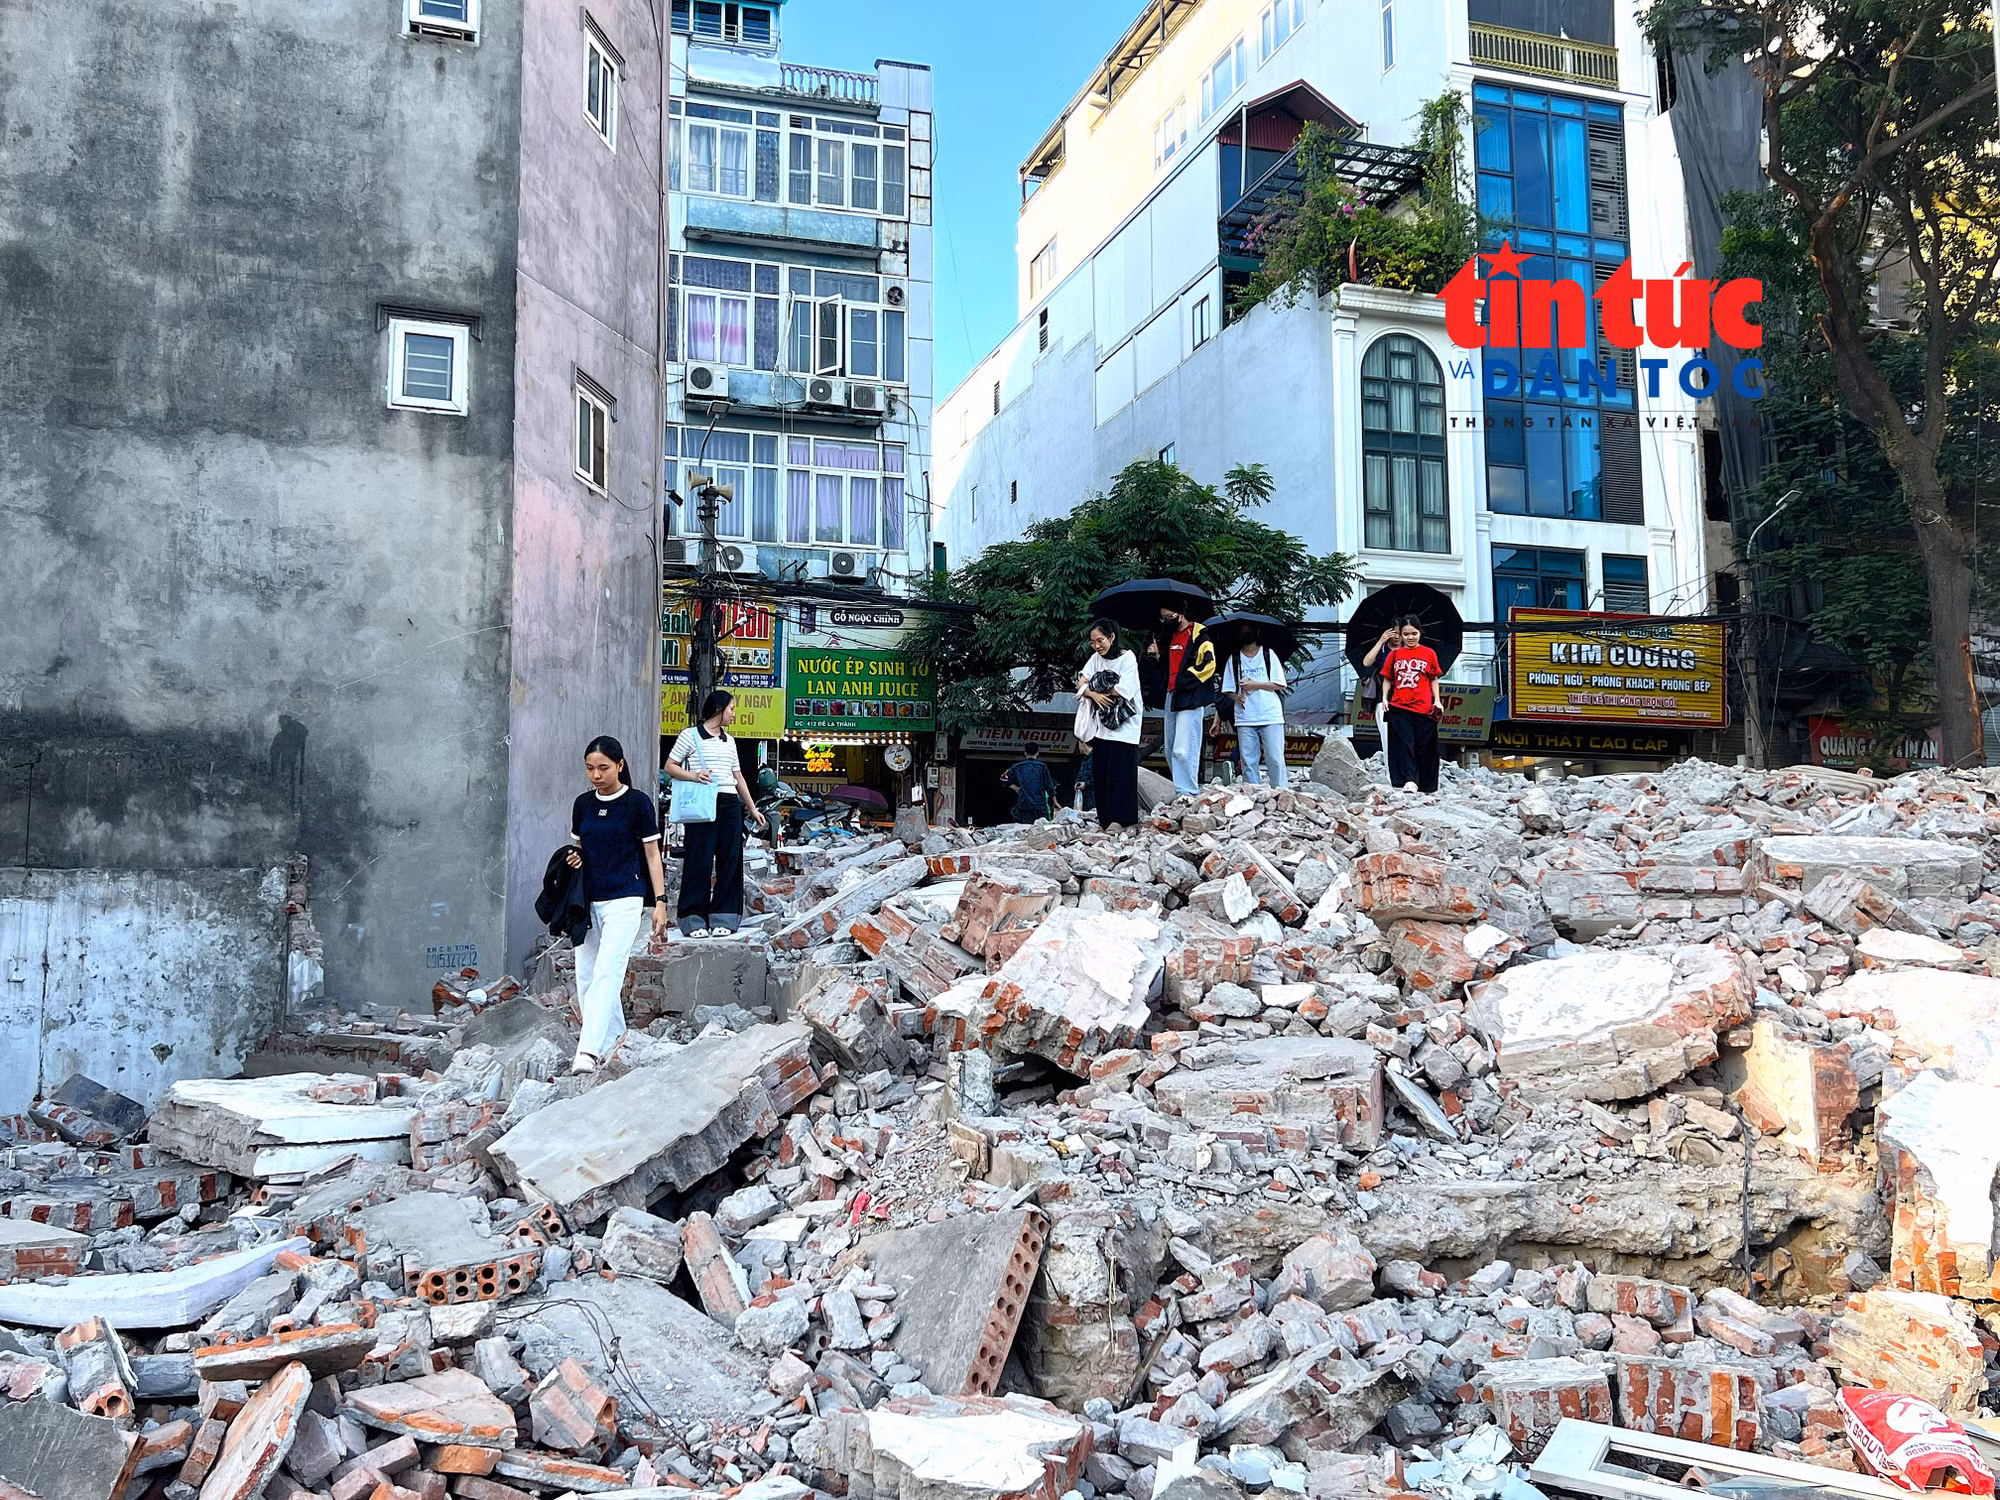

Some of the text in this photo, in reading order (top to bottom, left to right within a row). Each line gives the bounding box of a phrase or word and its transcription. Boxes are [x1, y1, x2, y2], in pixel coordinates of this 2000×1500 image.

[1551, 642, 1602, 665] KIM
[798, 656, 841, 675] NƯỚC
[845, 656, 864, 675] ÉP
[868, 661, 905, 676] SINH
[1528, 670, 1560, 686] PHÒNG
[807, 680, 919, 697] LAN ANH JUICE
[744, 695, 773, 708] NGAY
[740, 712, 755, 725] CŨ
[1590, 736, 1627, 750] CAO
